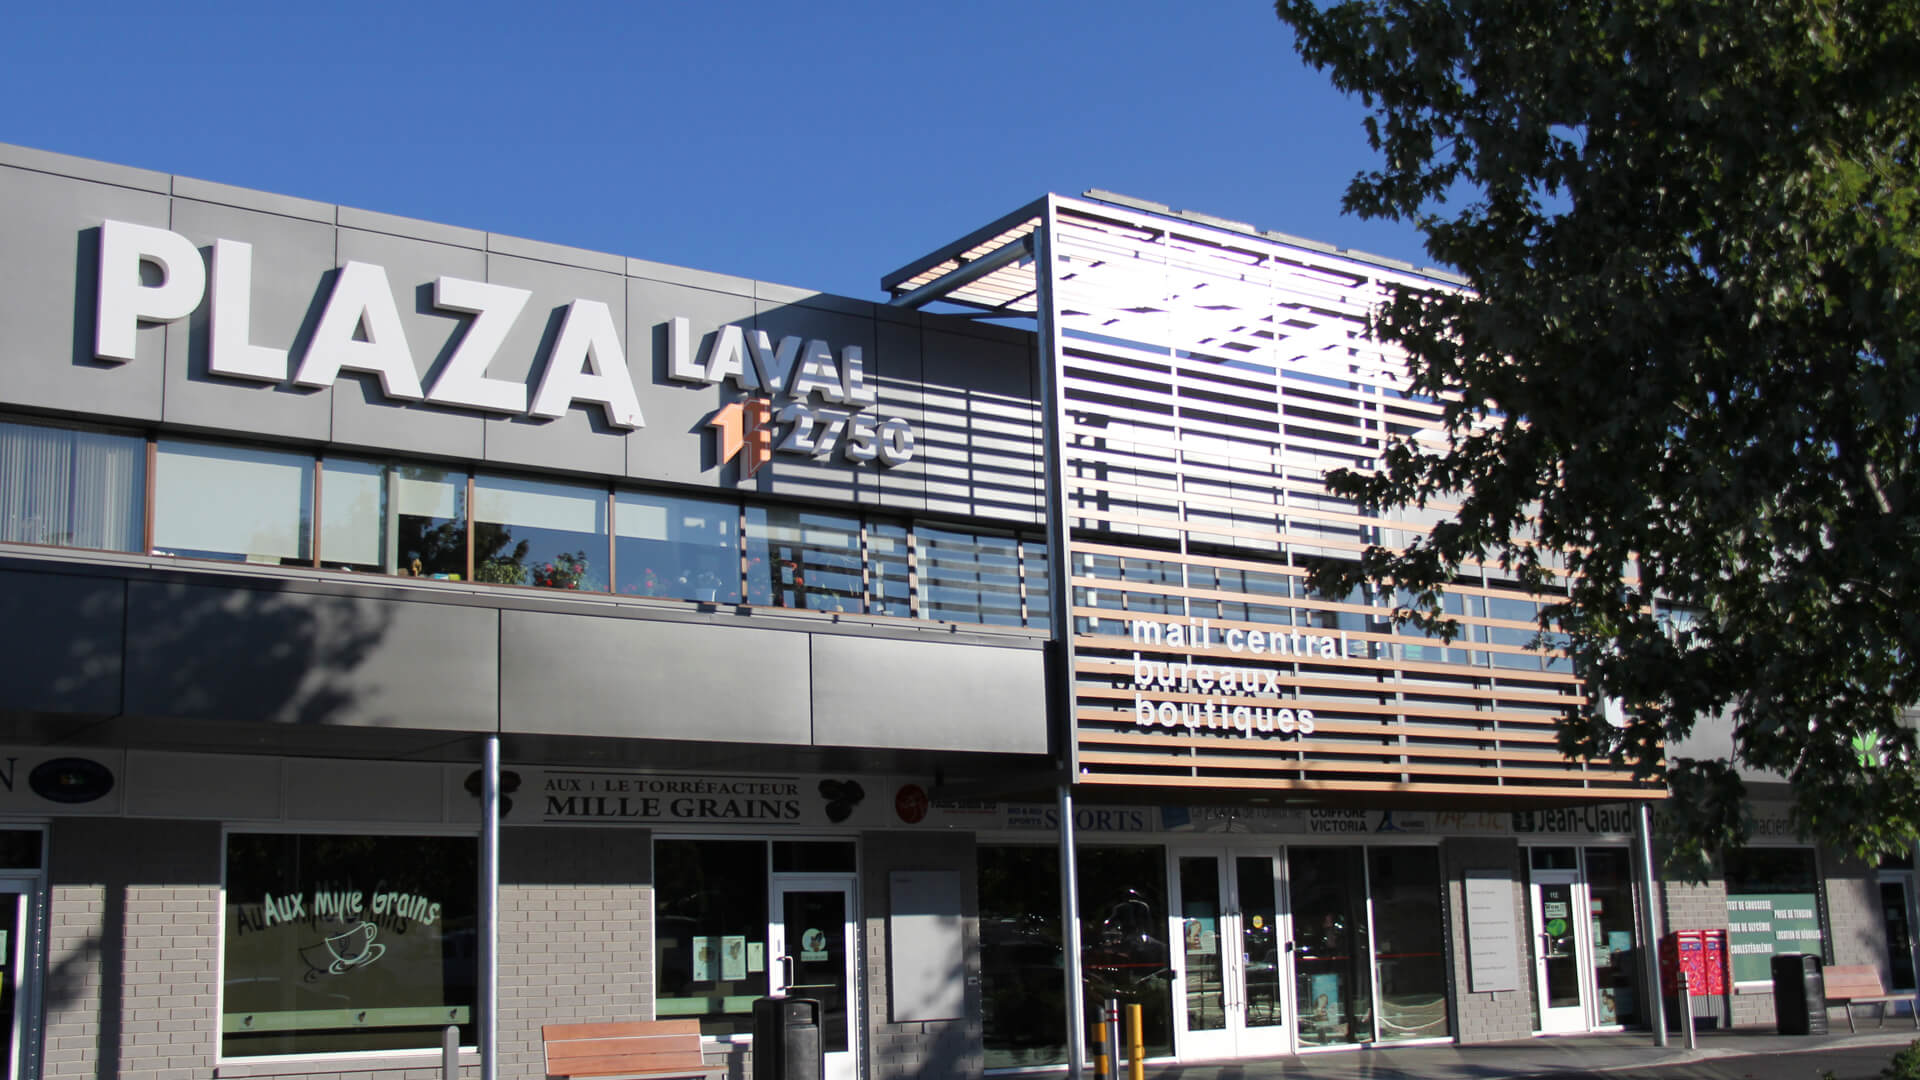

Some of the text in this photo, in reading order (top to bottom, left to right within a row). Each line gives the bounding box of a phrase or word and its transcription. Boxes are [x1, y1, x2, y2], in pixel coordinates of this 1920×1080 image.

[95, 219, 645, 431] PLAZA
[668, 316, 876, 406] LAVAL
[776, 403, 914, 467] 2750
[1133, 619, 1349, 660] mail central
[1134, 653, 1281, 694] bureaux
[1136, 694, 1315, 738] boutiques
[545, 777, 799, 796] AUX LE TORRÉFACTEUR
[545, 796, 800, 819] MILLE GRAINS
[1045, 808, 1144, 831] SORTS
[1310, 820, 1368, 832] VICTORIA
[1538, 803, 1638, 833] Jean-Claud
[264, 891, 441, 927] Aux Mille Grains
